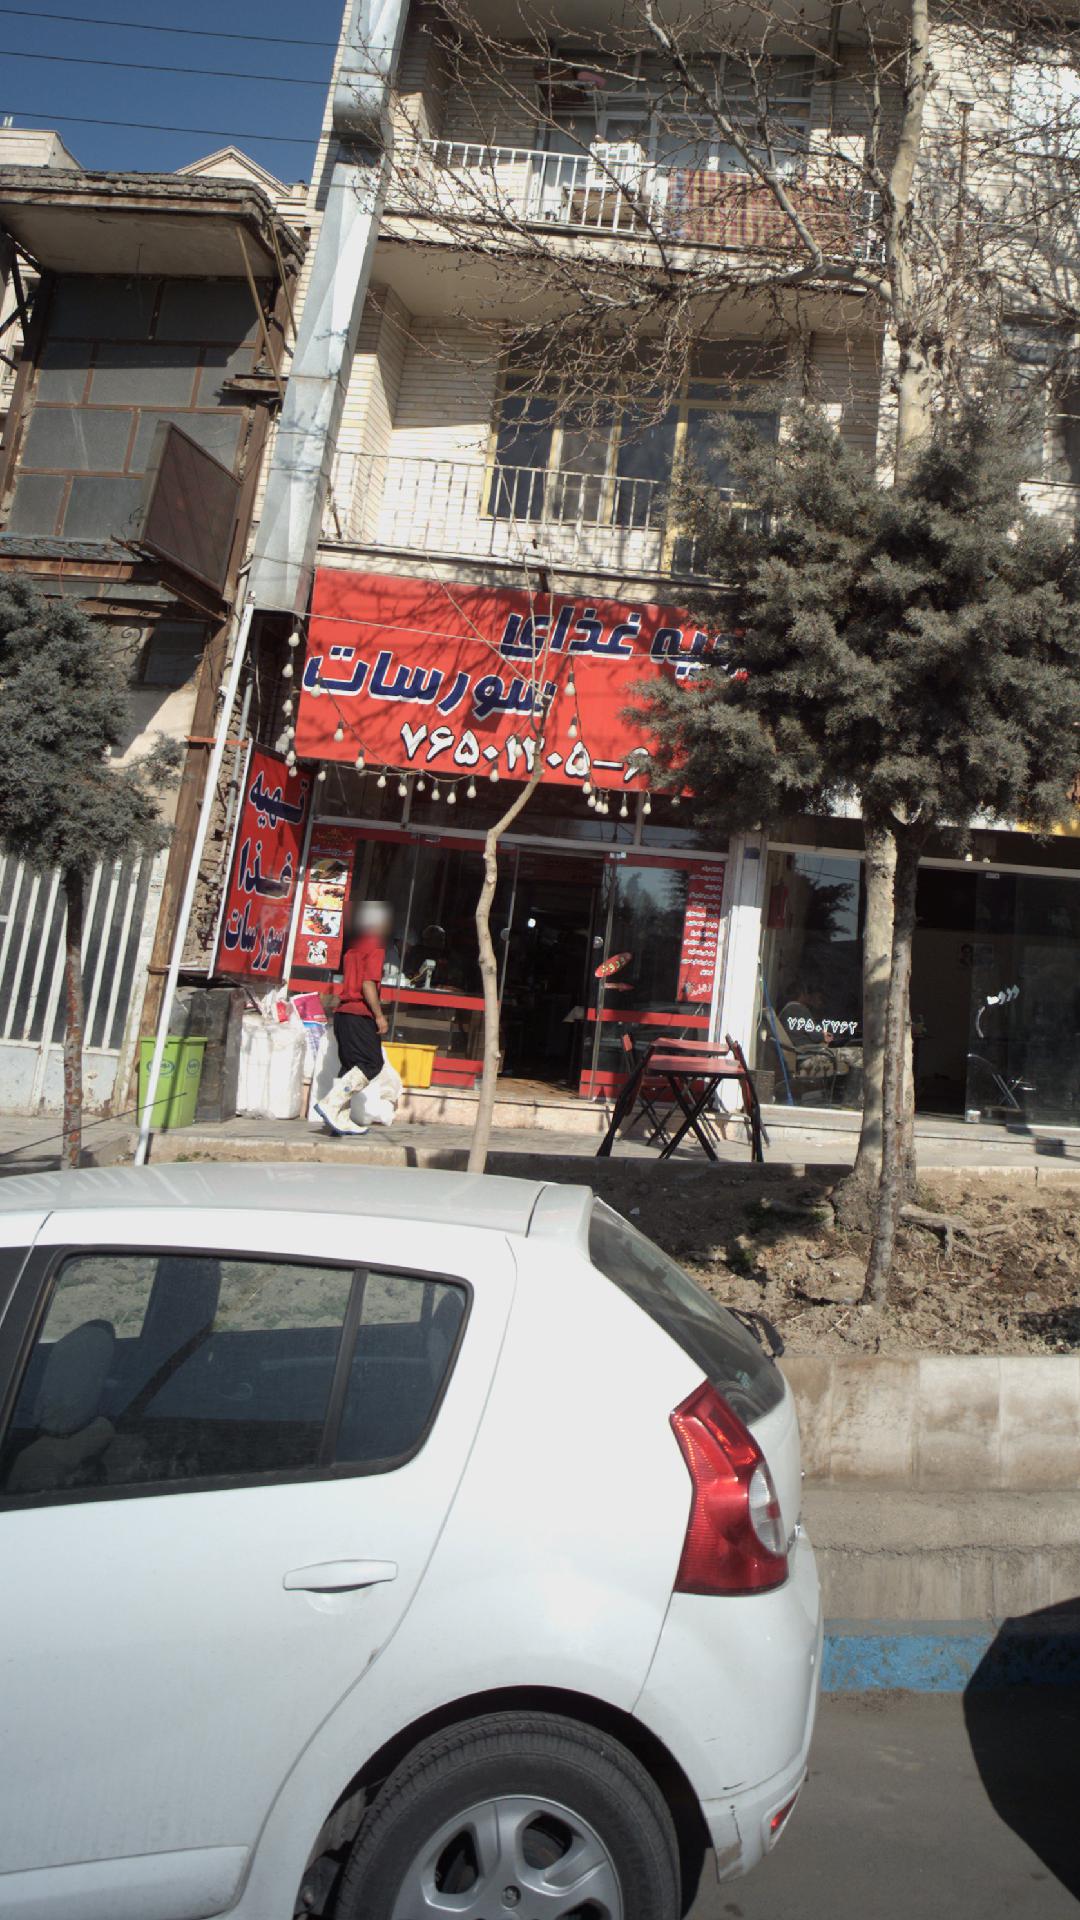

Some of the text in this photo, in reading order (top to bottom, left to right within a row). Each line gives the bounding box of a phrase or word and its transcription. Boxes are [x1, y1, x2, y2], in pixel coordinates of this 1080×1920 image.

[499, 605, 641, 663] غذای
[302, 645, 557, 720] سورسات
[249, 771, 309, 830] تهیه
[237, 838, 293, 899] غذا
[223, 899, 286, 971] سورسات
